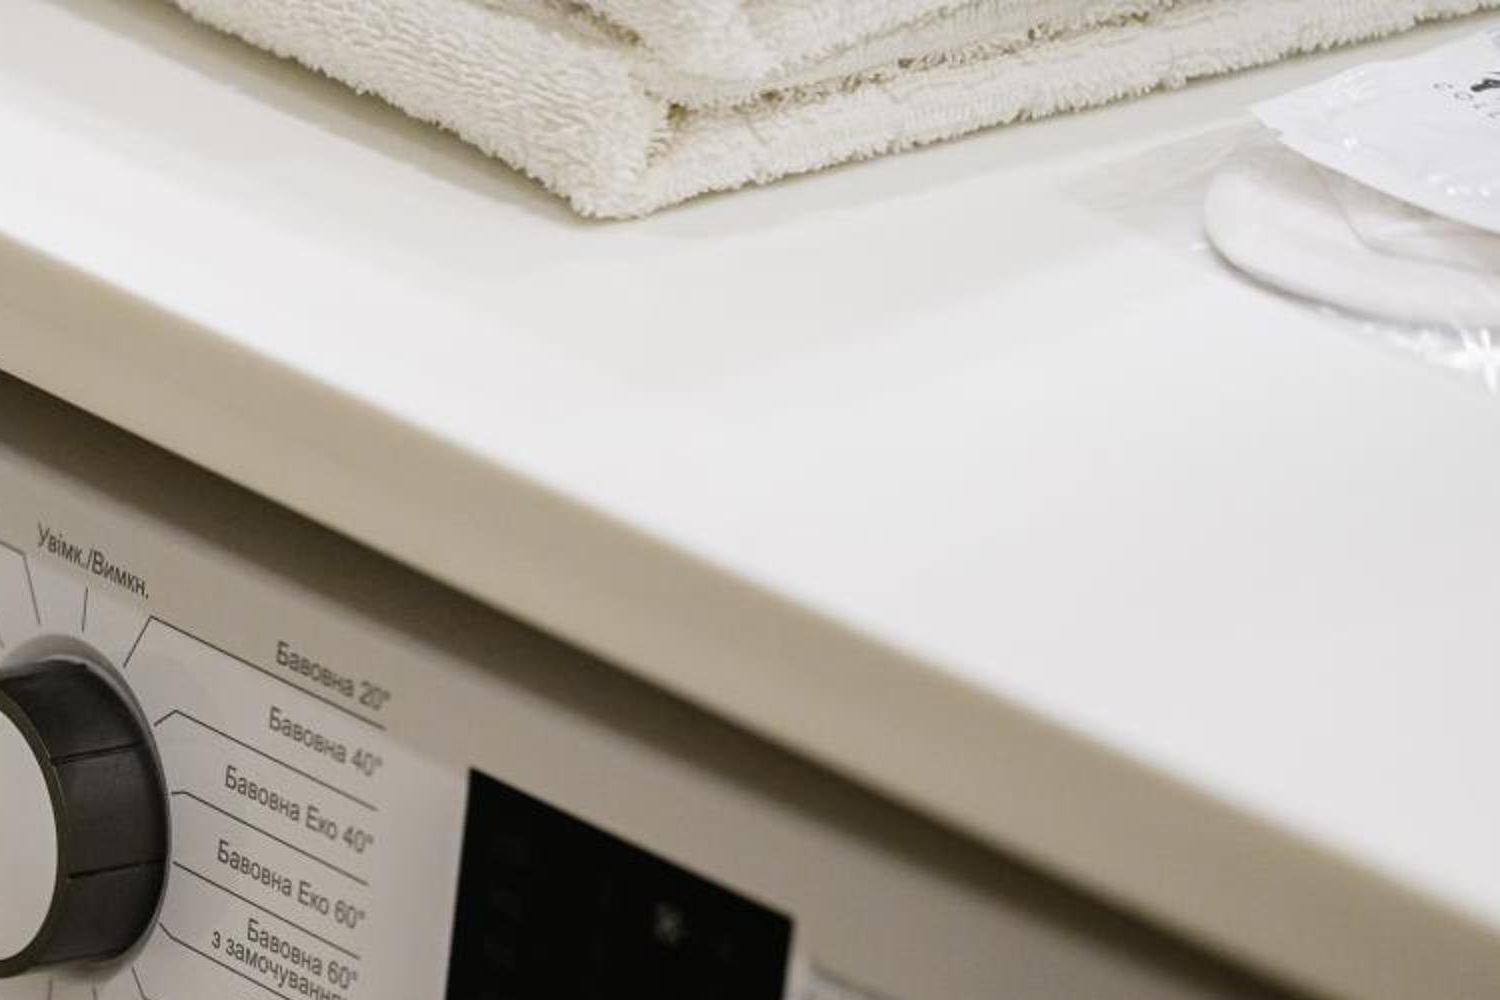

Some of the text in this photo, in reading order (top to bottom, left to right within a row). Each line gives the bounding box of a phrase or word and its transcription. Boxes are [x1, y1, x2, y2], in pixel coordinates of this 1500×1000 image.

[37, 520, 149, 600] Увімк./Вимкн.
[275, 640, 391, 711] Бавовна 20°
[268, 705, 383, 777] Бавовна 40°
[224, 764, 374, 855] Бавовна Еко 40°
[216, 838, 366, 929] Бавовна Еко 60°
[246, 917, 358, 991] Бавовна 60°
